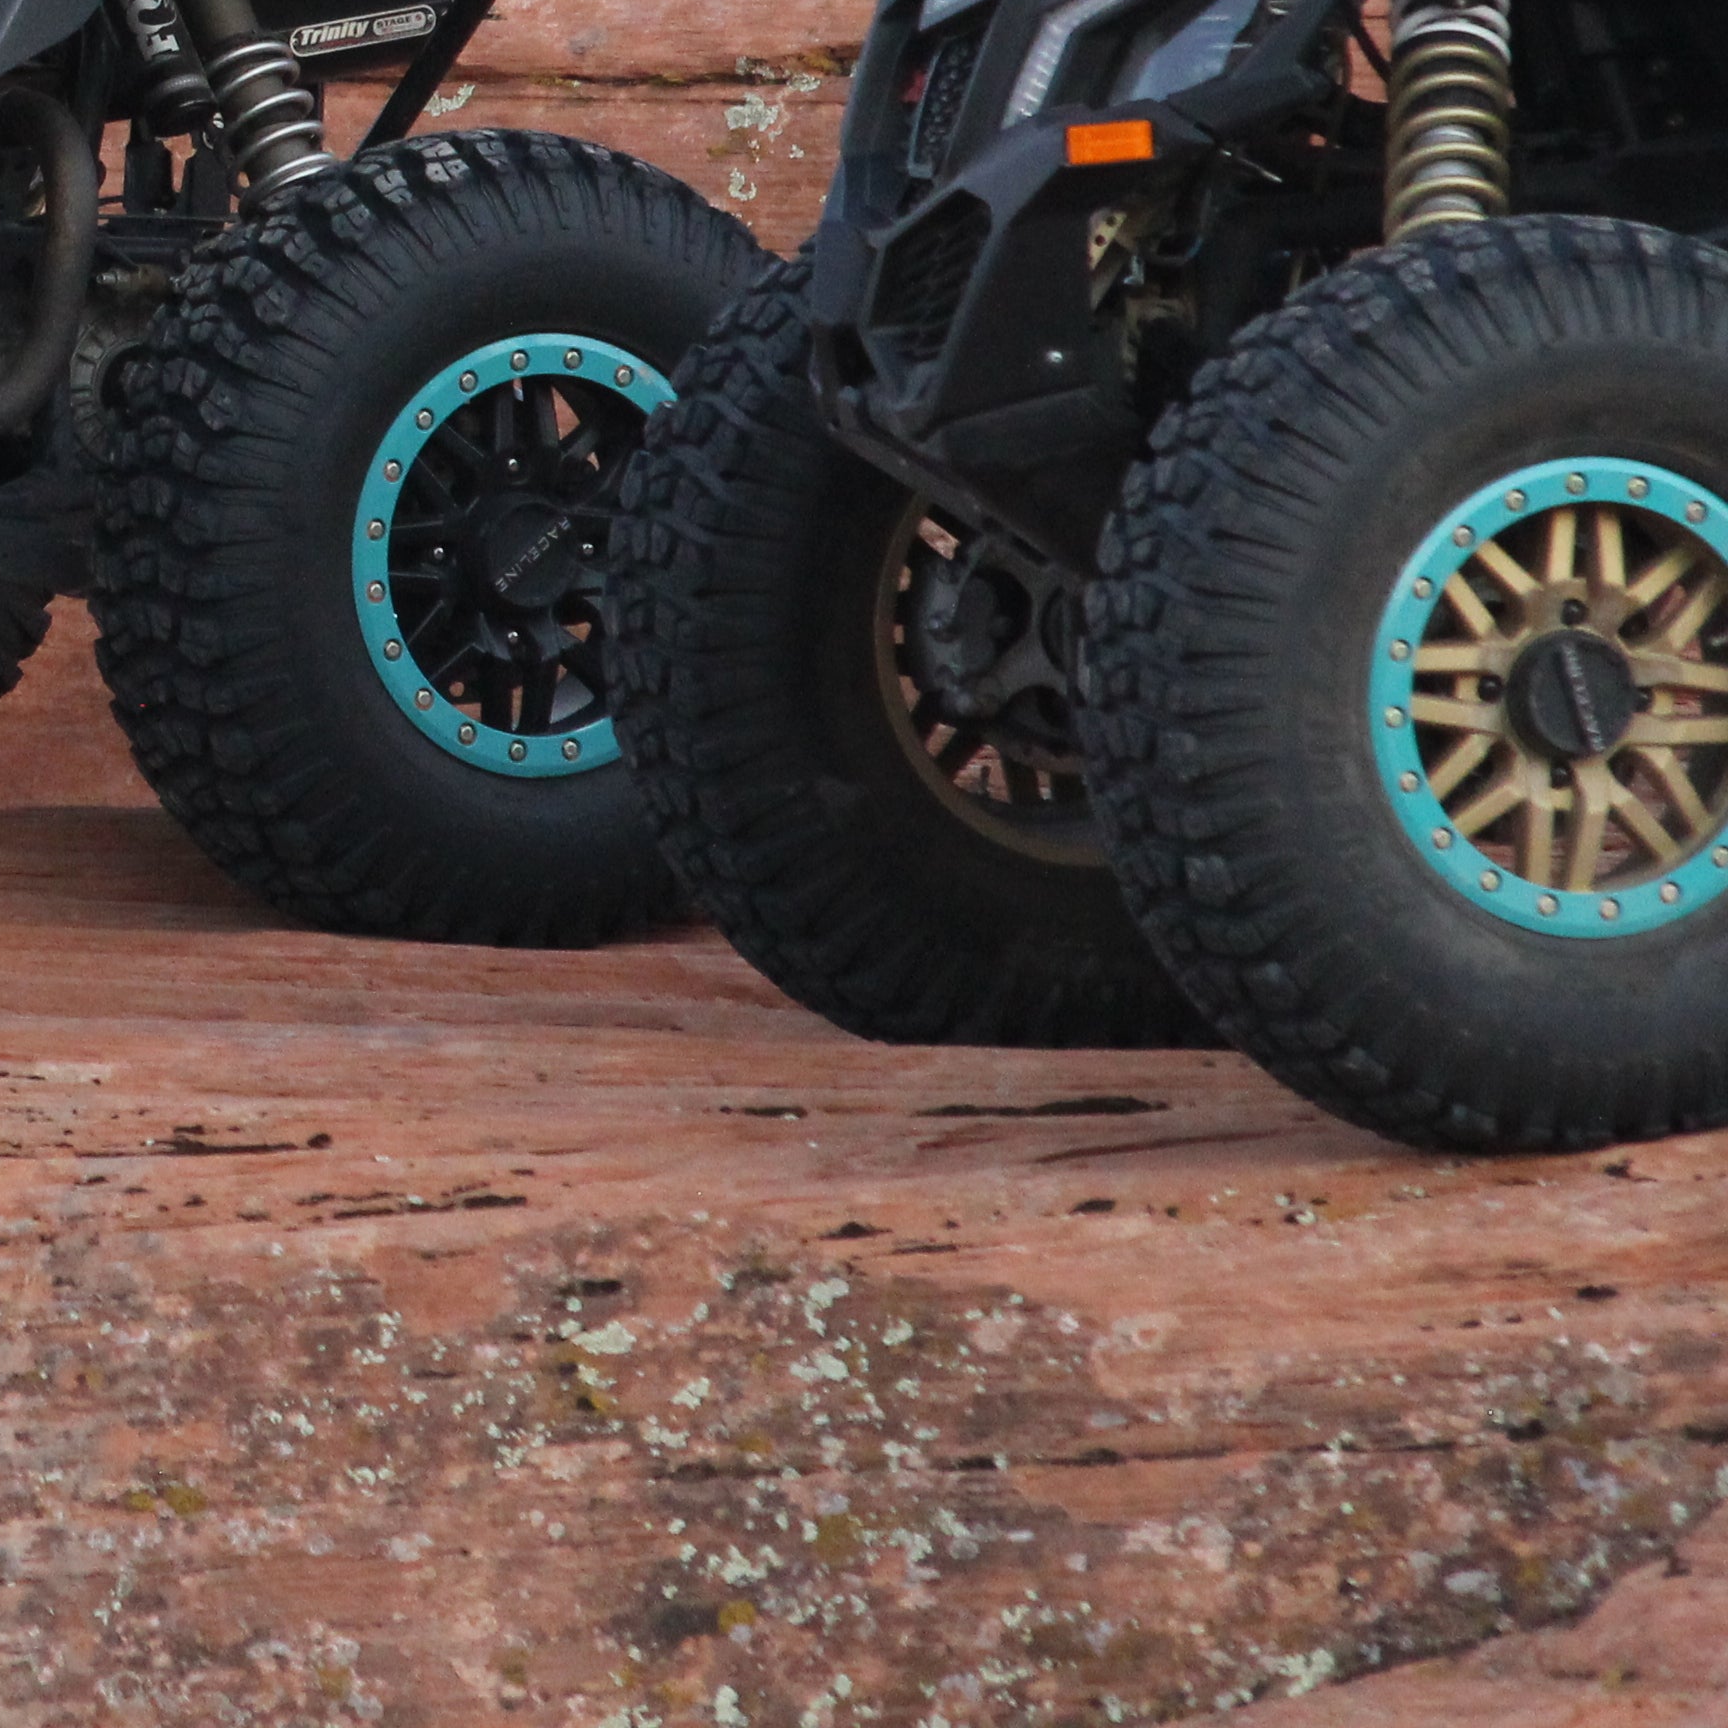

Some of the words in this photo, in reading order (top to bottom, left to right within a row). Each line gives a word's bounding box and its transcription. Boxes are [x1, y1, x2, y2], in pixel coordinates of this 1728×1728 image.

[300, 20, 370, 46] Trinity
[376, 16, 412, 29] STAGE
[494, 516, 571, 593] RACELINE
